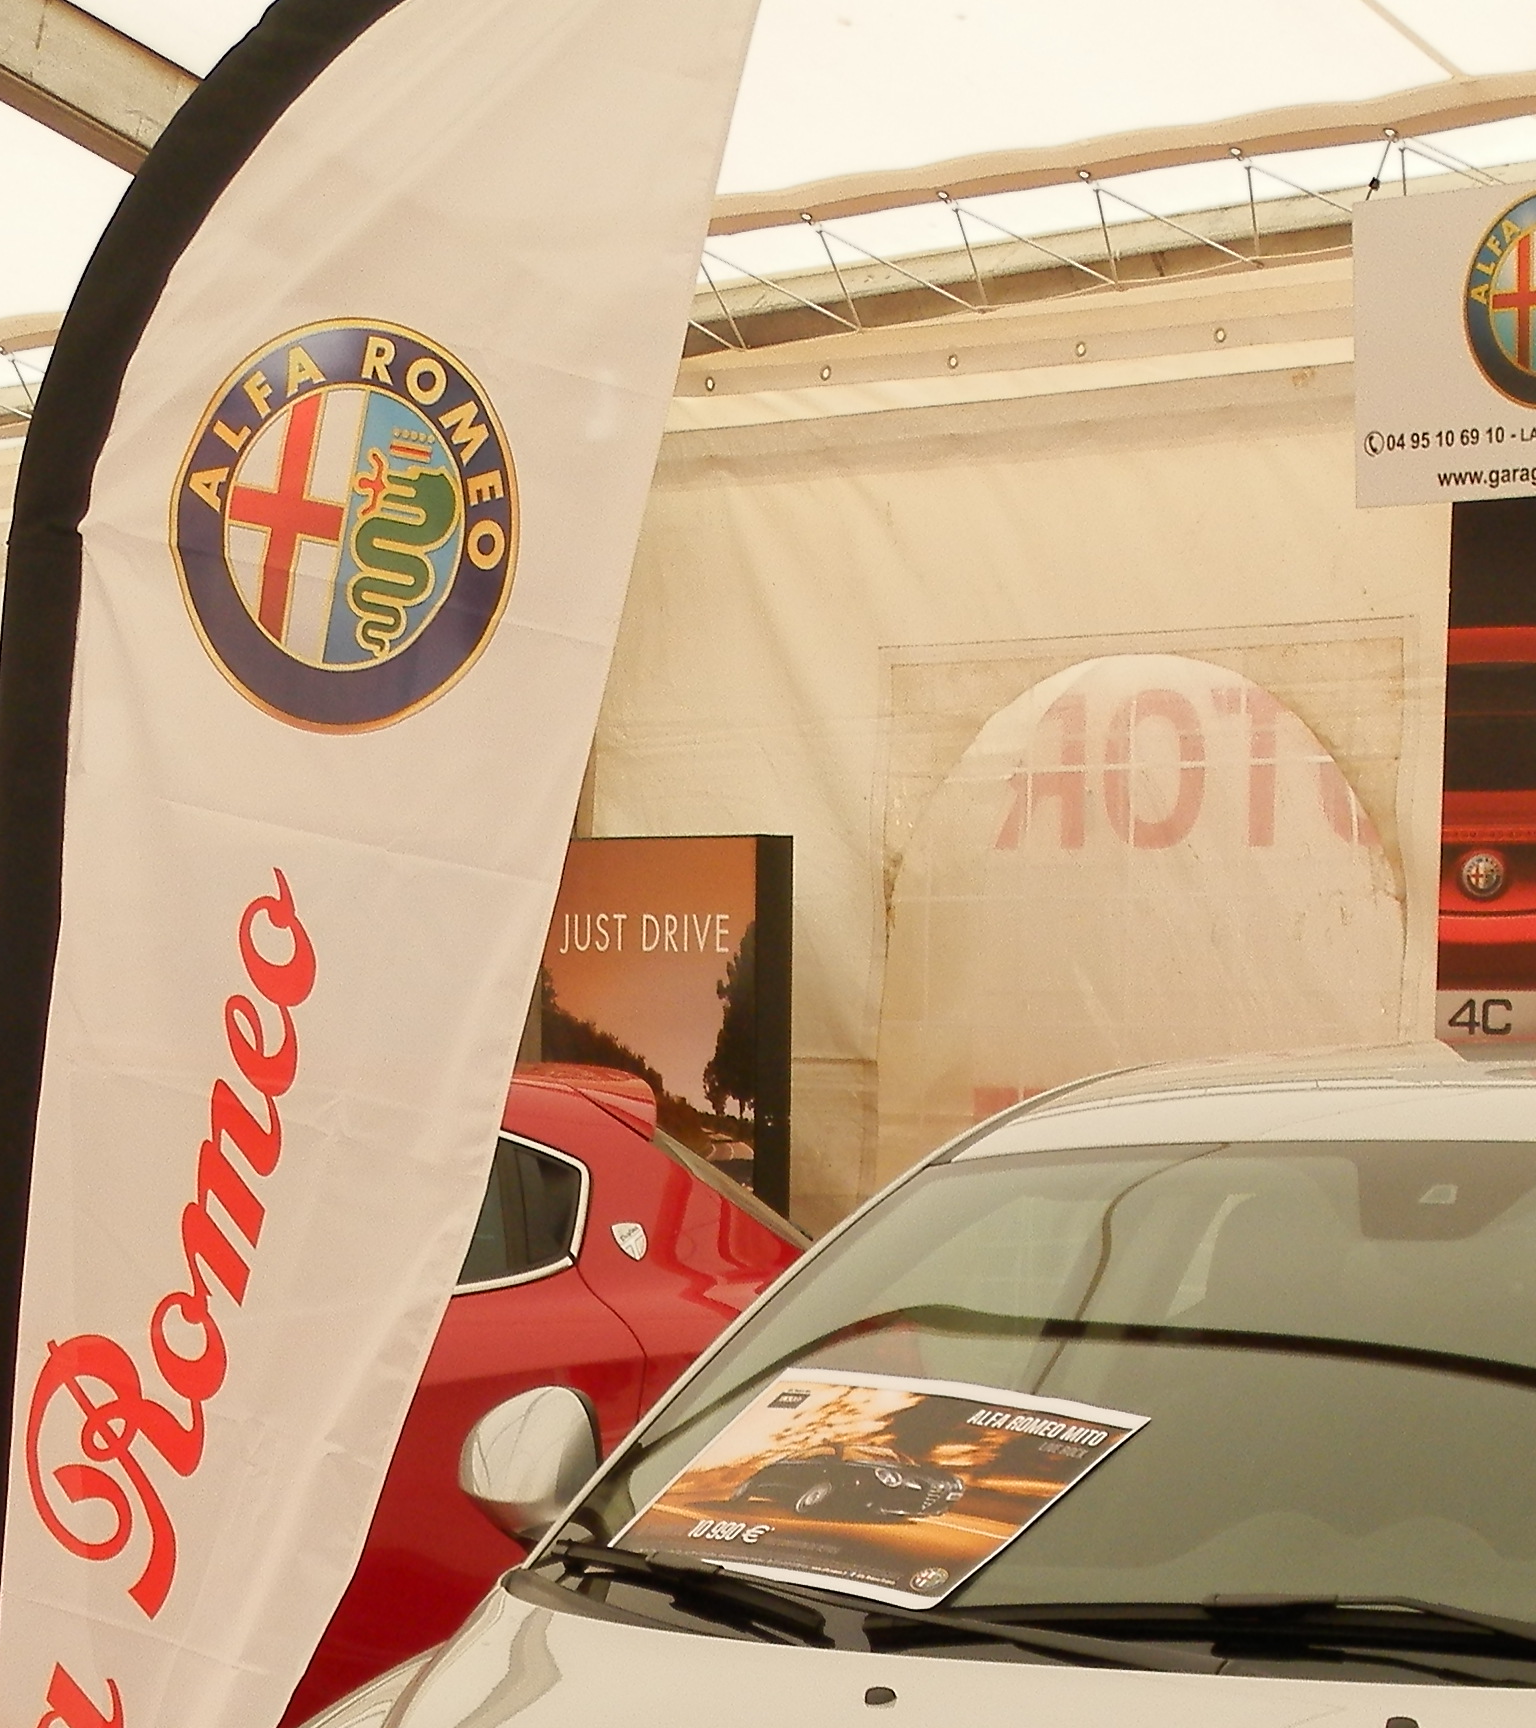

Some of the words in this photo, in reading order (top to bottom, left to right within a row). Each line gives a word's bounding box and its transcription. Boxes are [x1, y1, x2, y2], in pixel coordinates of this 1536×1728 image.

[1470, 220, 1521, 304] ALFA
[188, 345, 326, 513] ALFA
[360, 335, 506, 571] ROMEO
[1386, 433, 1406, 452] 04
[1410, 431, 1431, 450] 95
[1435, 430, 1455, 448] 10
[1460, 428, 1480, 447] 69
[1485, 426, 1505, 445] 10
[560, 913, 627, 955] JUST
[641, 913, 730, 953] DRIVE
[1447, 997, 1513, 1036] 4C
[26, 867, 318, 1623] Romeo
[967, 1408, 1012, 1430] ALFA
[1006, 1415, 1066, 1439] ROMEO
[1060, 1425, 1109, 1447] MITO
